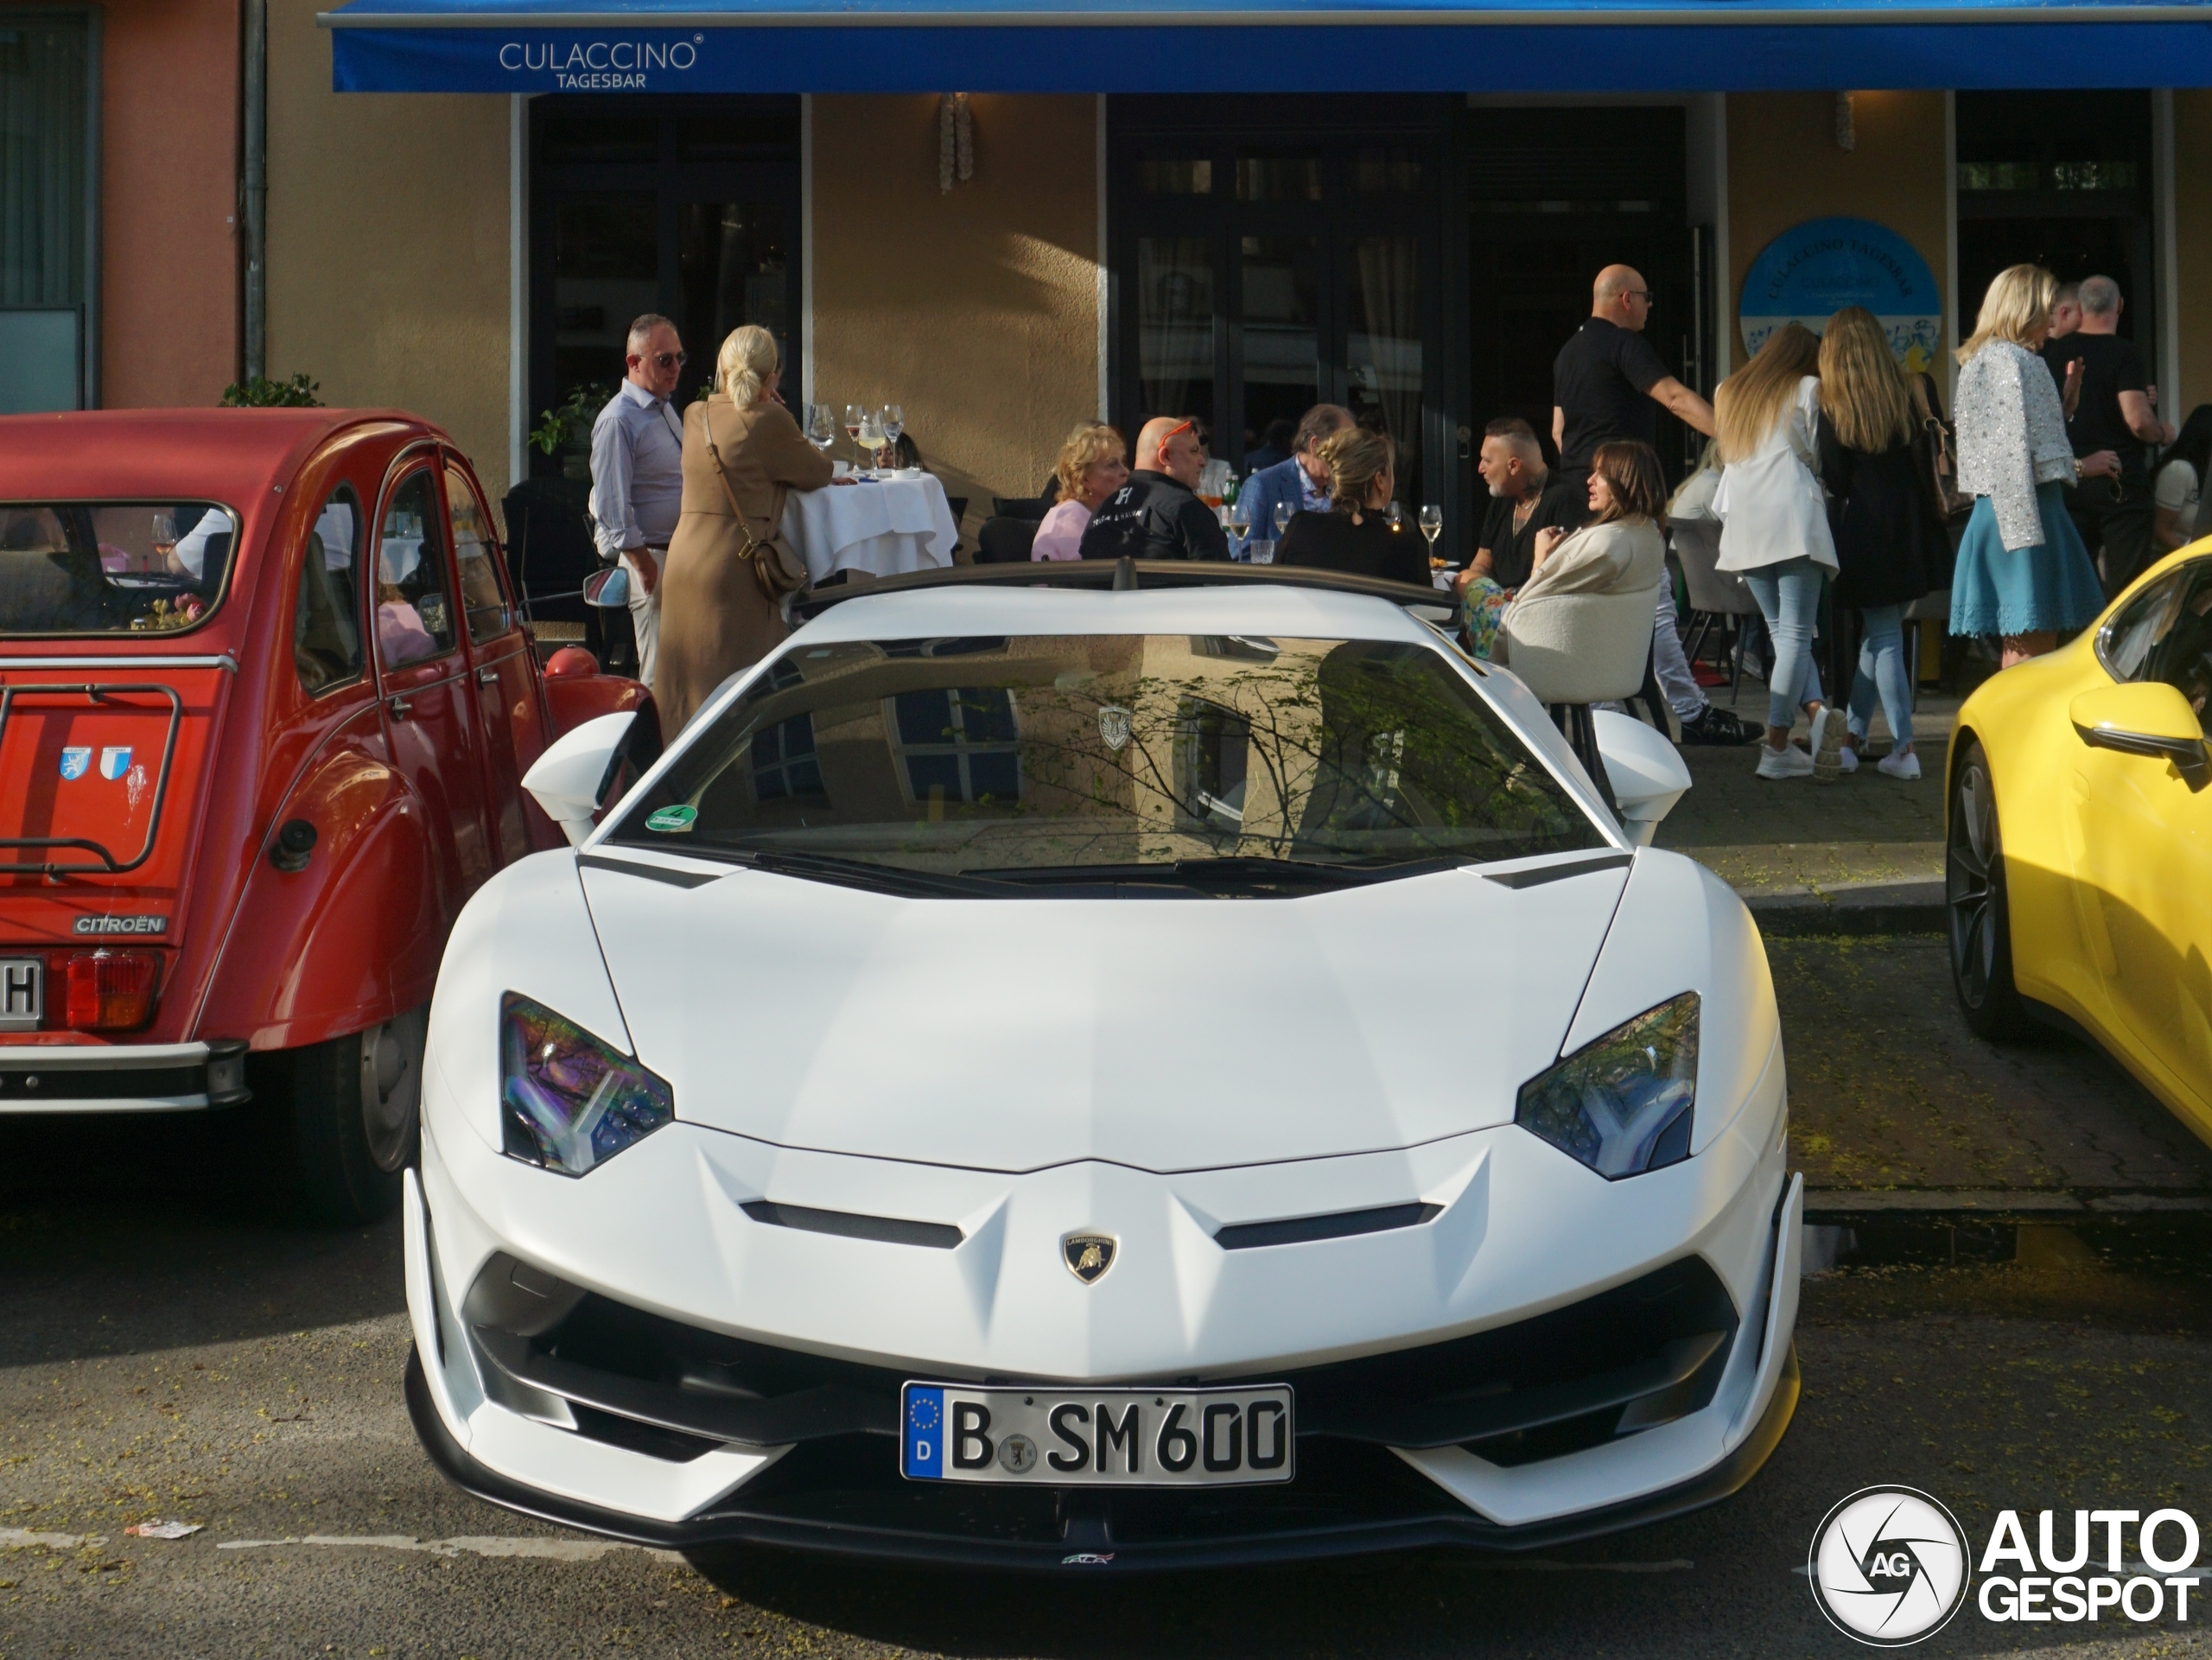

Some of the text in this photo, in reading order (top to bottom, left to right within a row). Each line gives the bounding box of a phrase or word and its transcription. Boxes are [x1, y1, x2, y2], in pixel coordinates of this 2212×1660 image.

[556, 73, 646, 88] TAGESBAR
[1768, 238, 1913, 300] CULACCINO TAGESBAR
[77, 916, 162, 932] CITROËN
[1067, 1237, 1112, 1246] LAMBORGHINI
[951, 1400, 994, 1469] B
[917, 1441, 931, 1460] D
